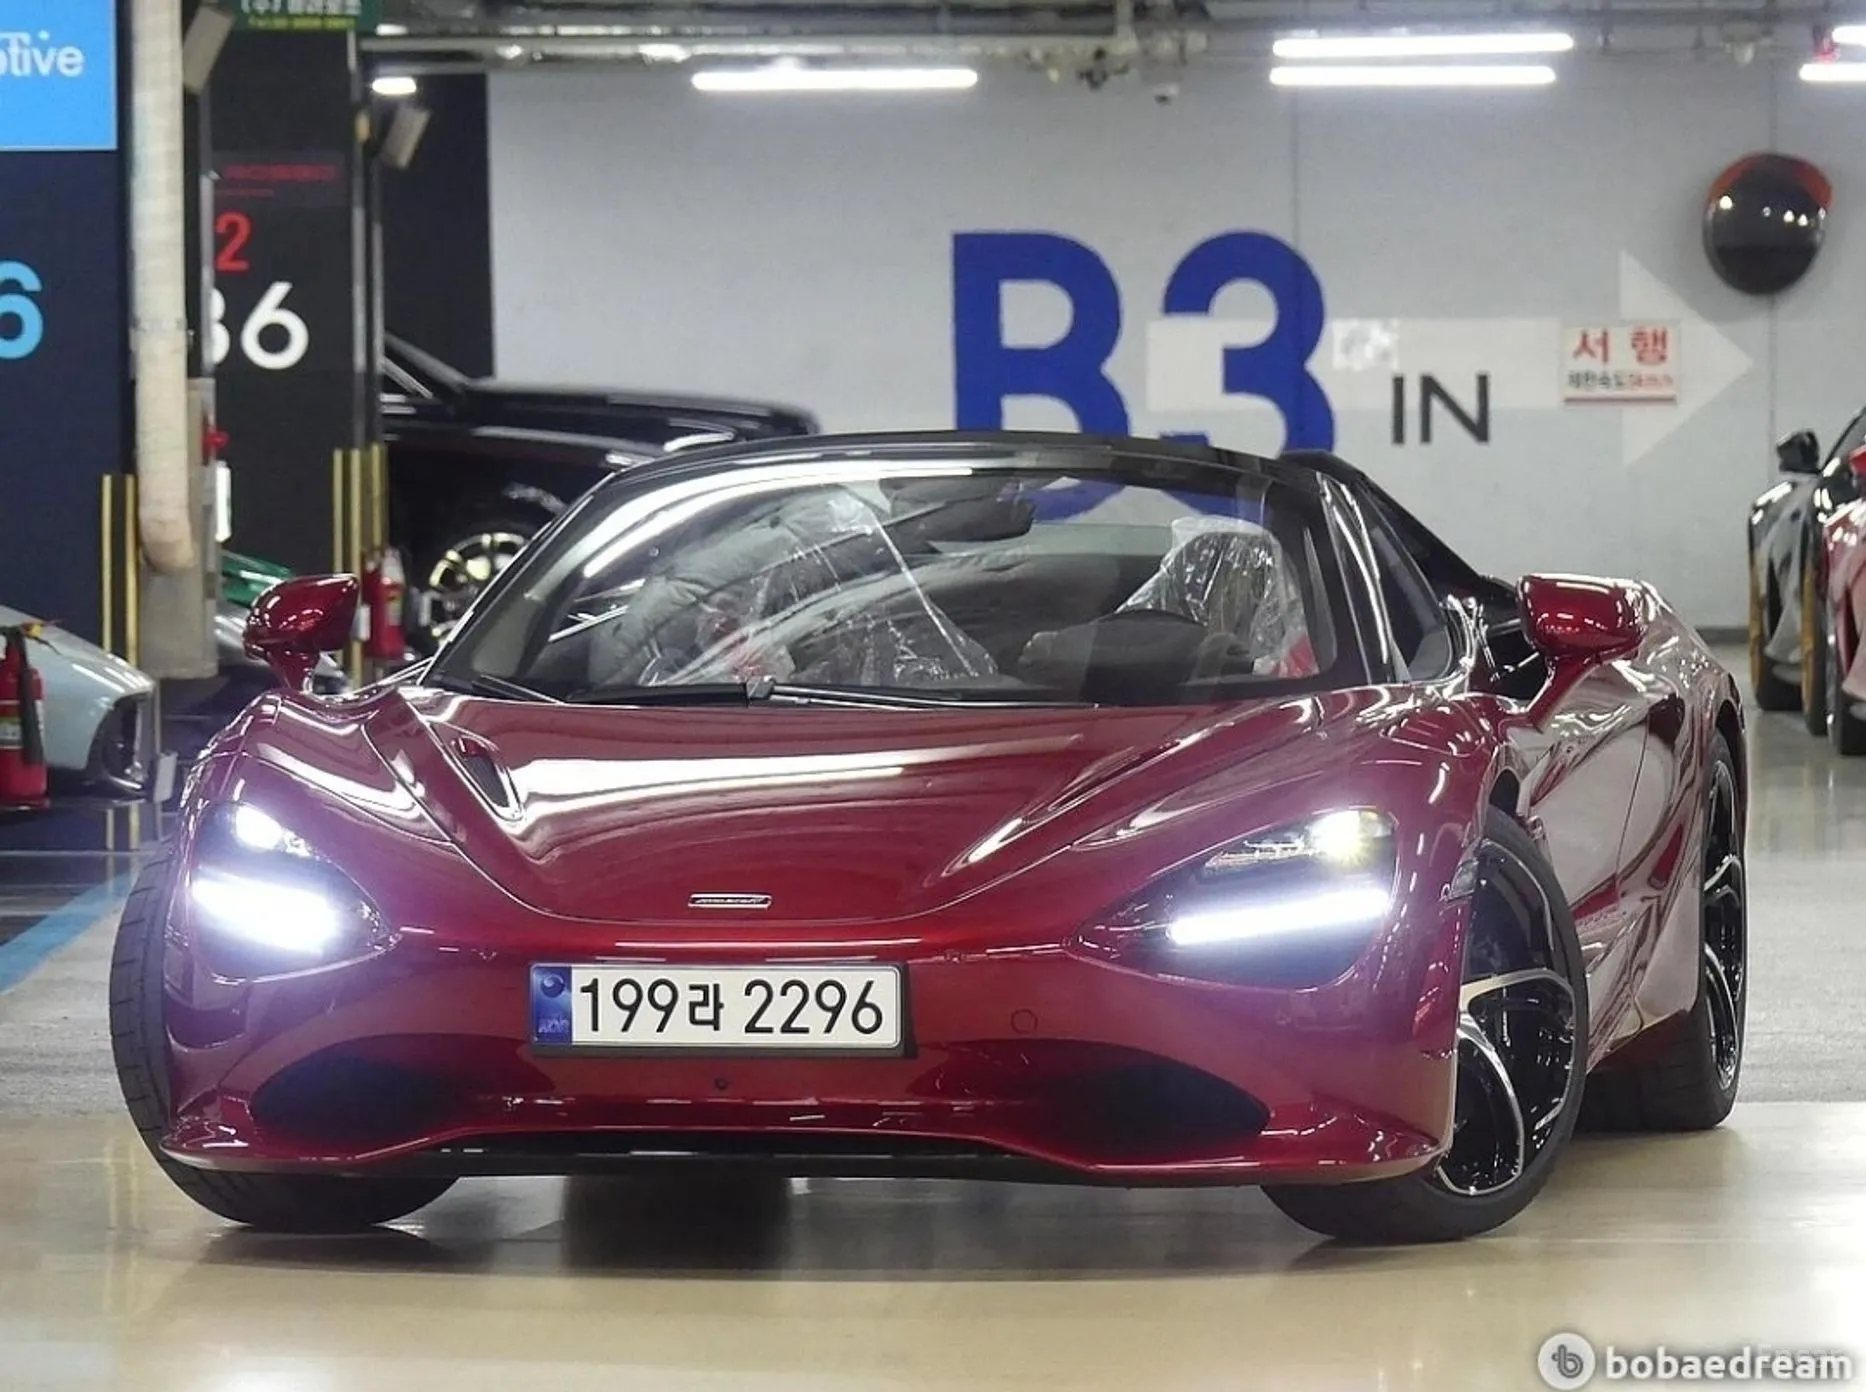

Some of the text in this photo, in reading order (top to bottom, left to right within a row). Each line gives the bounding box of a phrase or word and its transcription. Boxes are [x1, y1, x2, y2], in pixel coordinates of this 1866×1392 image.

[0, 31, 85, 77] tive
[952, 229, 1336, 520] B3
[1392, 372, 1490, 446] IN
[580, 978, 884, 1035] 199라 2296
